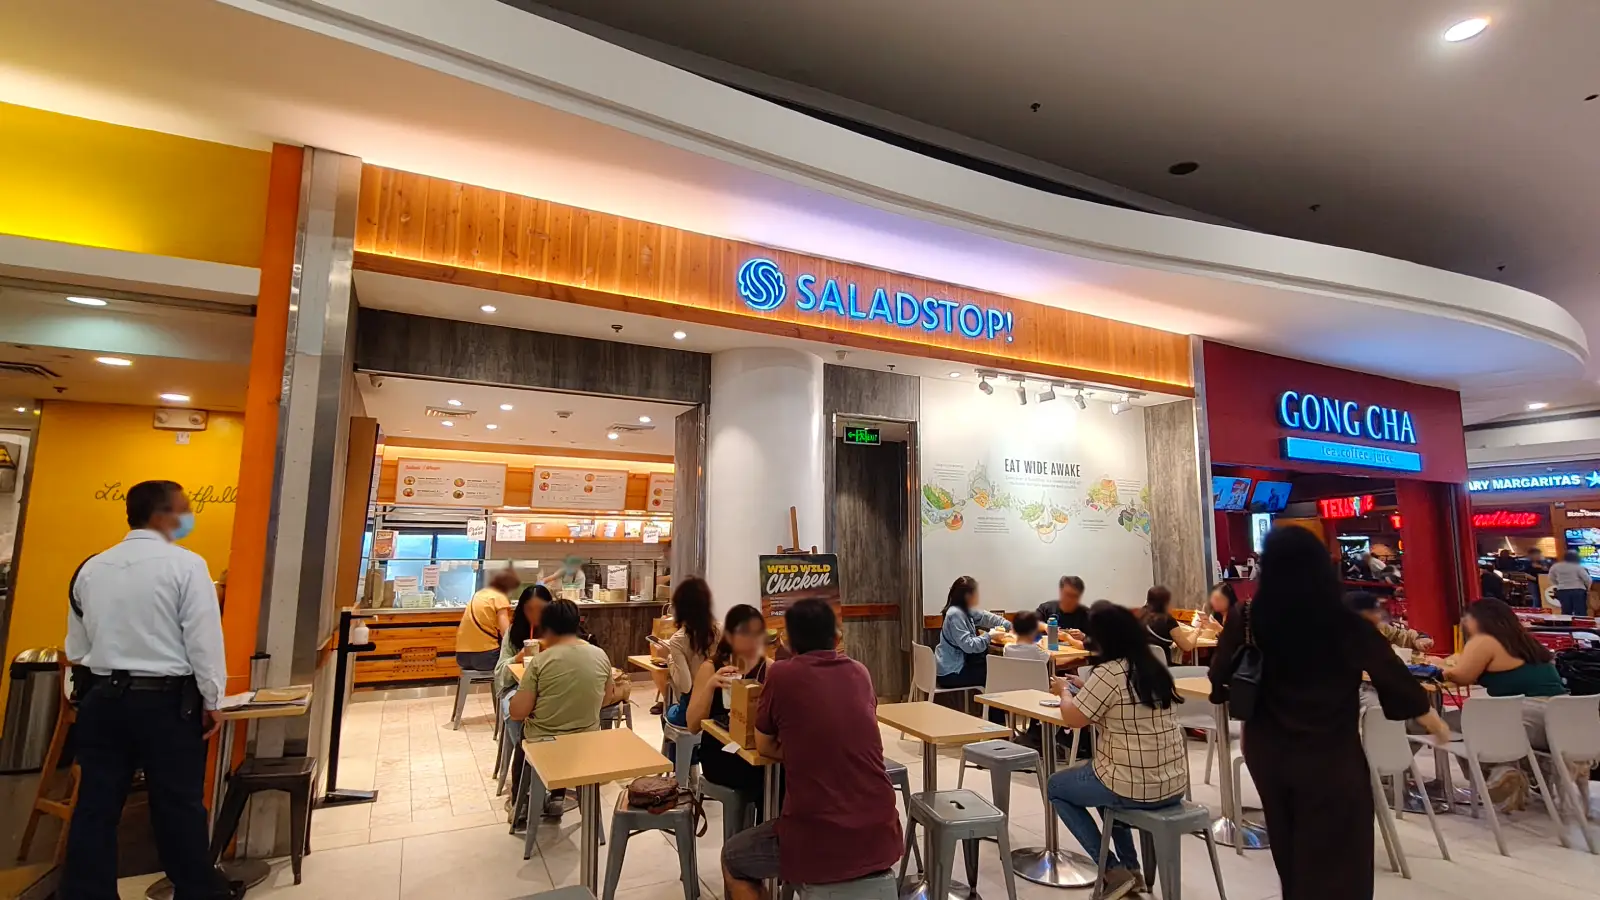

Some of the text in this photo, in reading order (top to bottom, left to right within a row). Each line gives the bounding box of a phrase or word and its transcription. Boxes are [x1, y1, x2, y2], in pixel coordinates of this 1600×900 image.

[795, 273, 1014, 343] SALADSTOP!
[1280, 390, 1417, 444] GONG CHA
[1004, 458, 1081, 478] EAT WIDE AWAKE
[1492, 474, 1581, 490] MARGARITAS
[766, 571, 831, 595] Chicken
